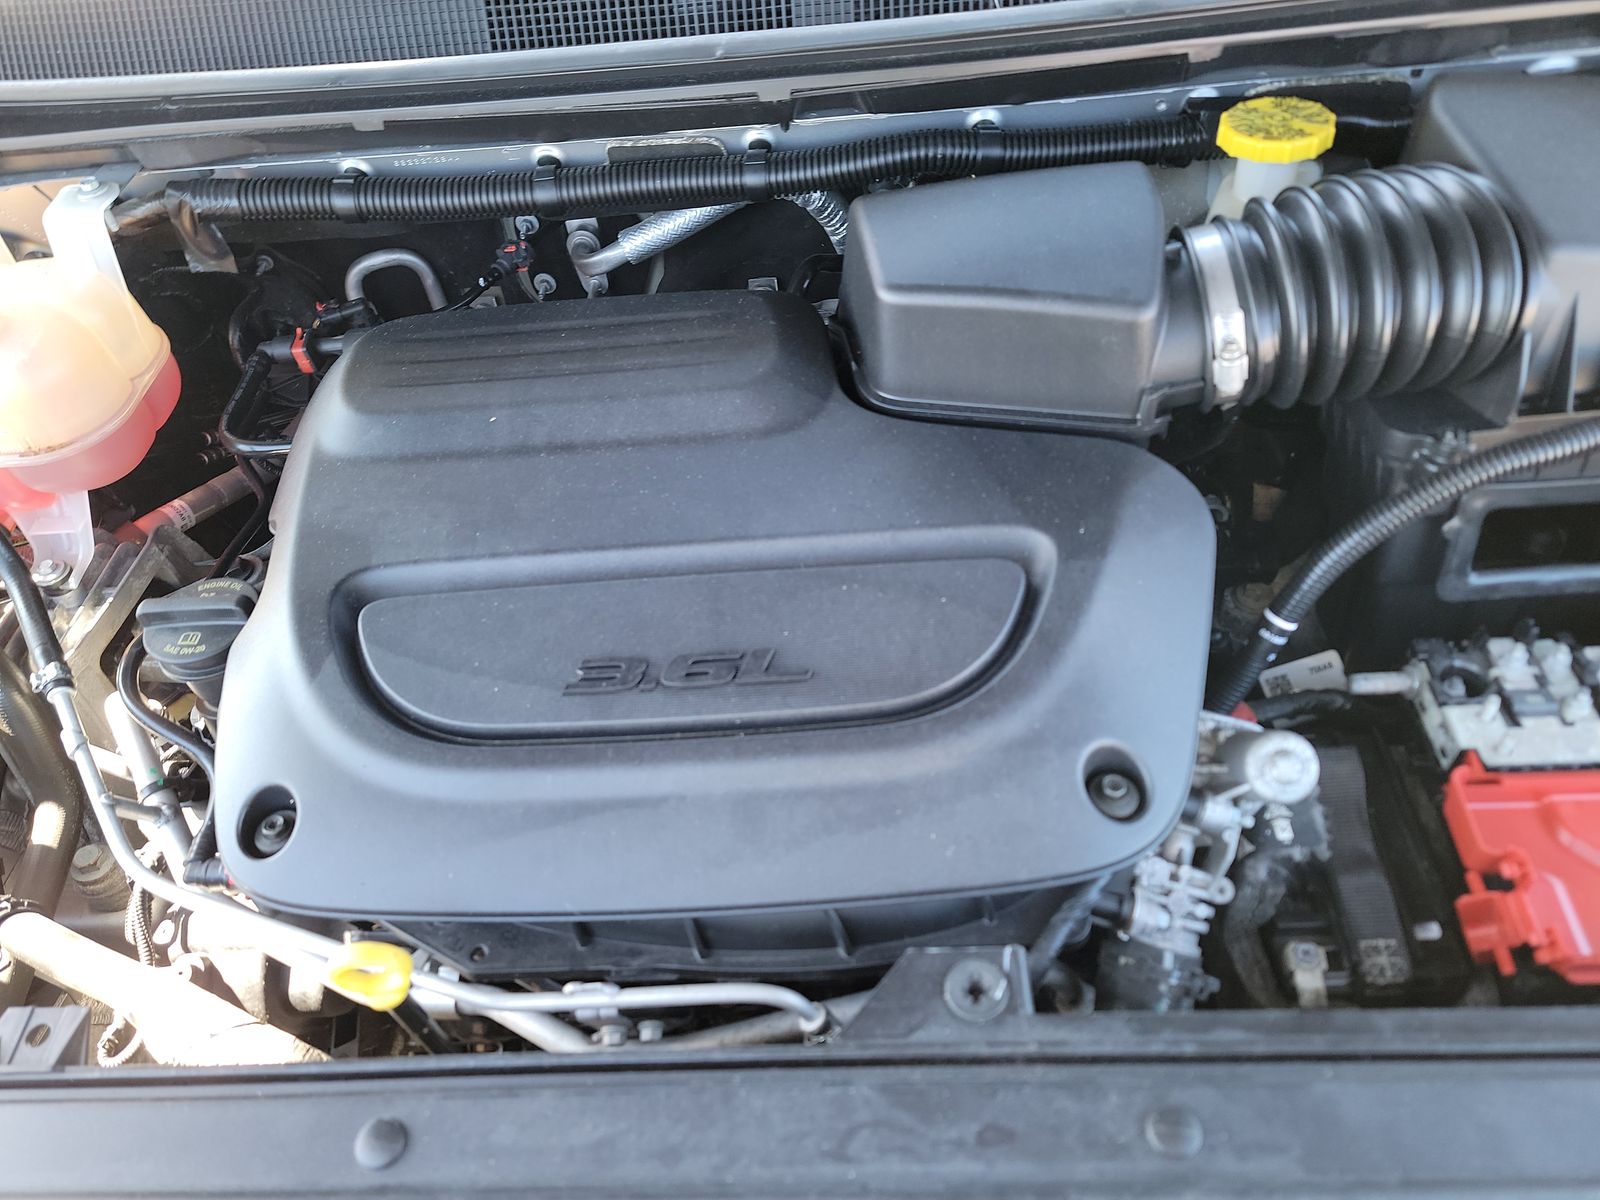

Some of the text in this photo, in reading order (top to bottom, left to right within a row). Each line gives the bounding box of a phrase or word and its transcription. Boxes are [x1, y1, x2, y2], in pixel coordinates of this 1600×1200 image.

[198, 581, 243, 591] ENGINE OIL
[164, 645, 206, 655] SAE 0W-20
[562, 649, 815, 696] 3.6L
